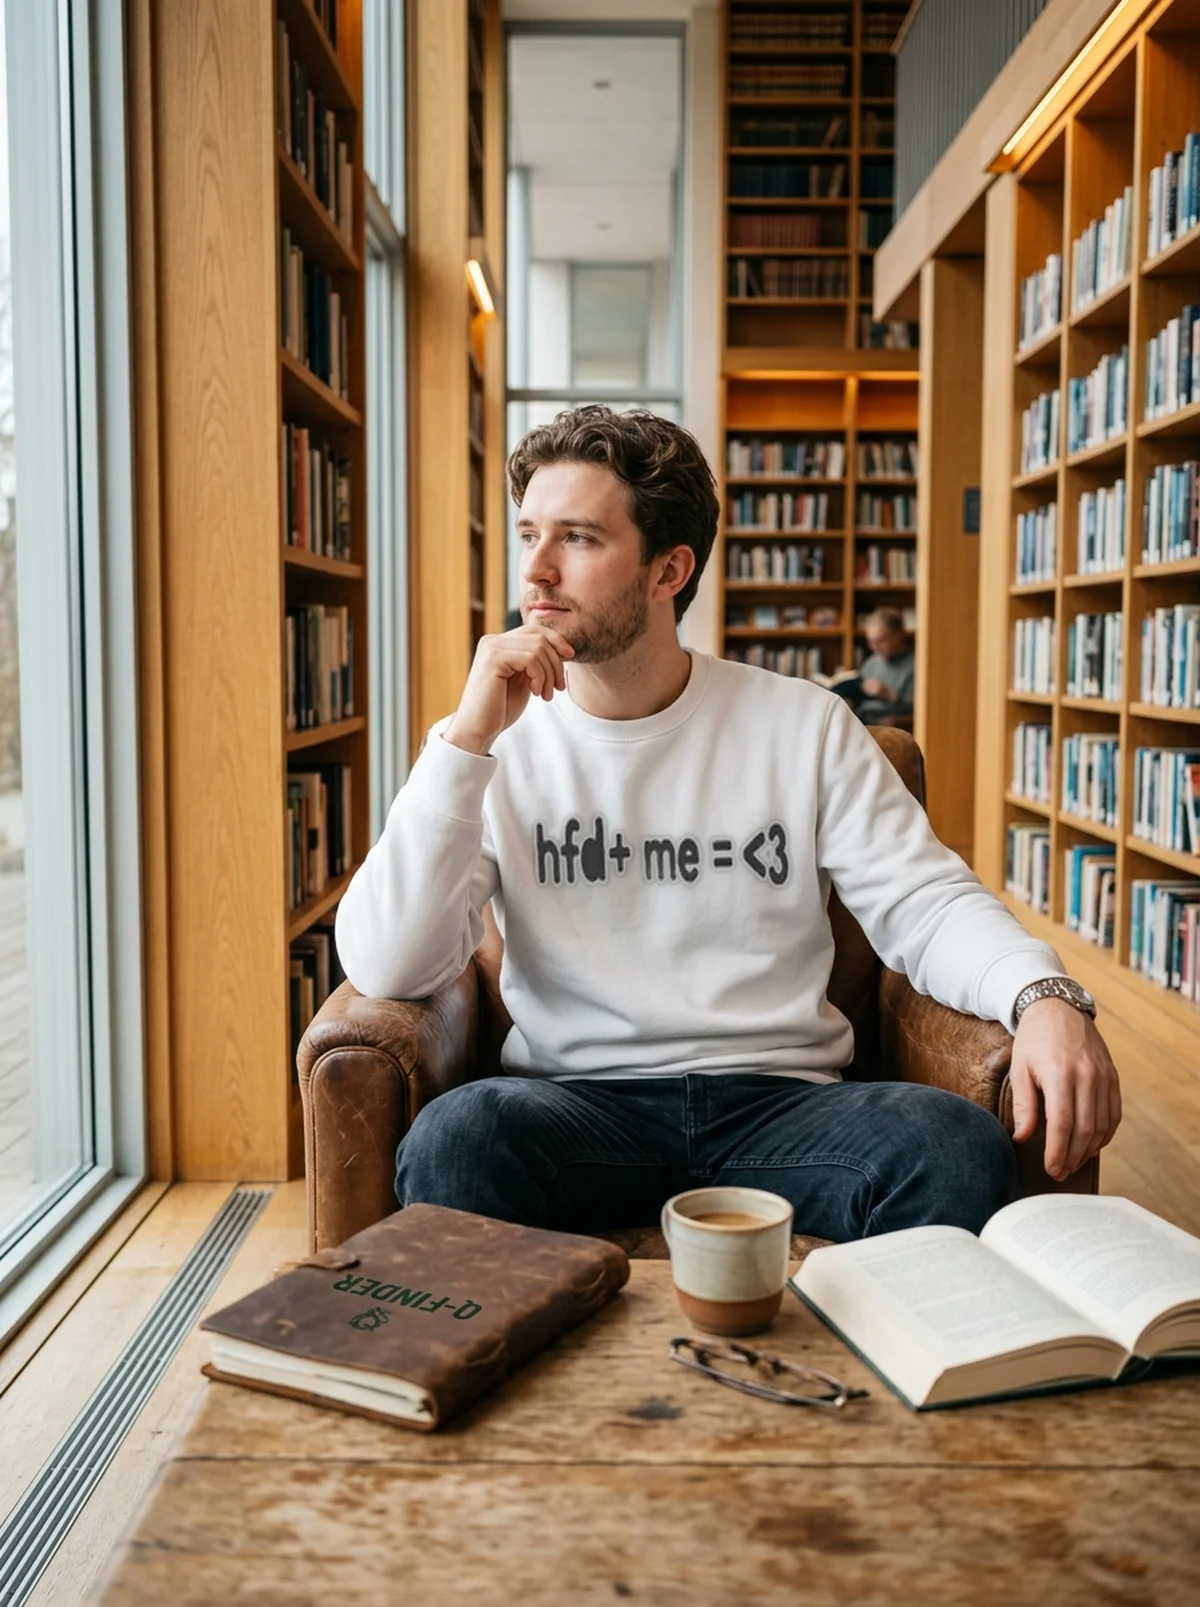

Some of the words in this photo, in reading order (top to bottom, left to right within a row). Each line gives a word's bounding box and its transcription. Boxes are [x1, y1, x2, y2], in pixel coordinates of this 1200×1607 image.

[644, 838, 700, 882] me
[712, 839, 733, 868] =
[743, 823, 789, 885] <3
[333, 1273, 482, 1320] Q-FINDER
